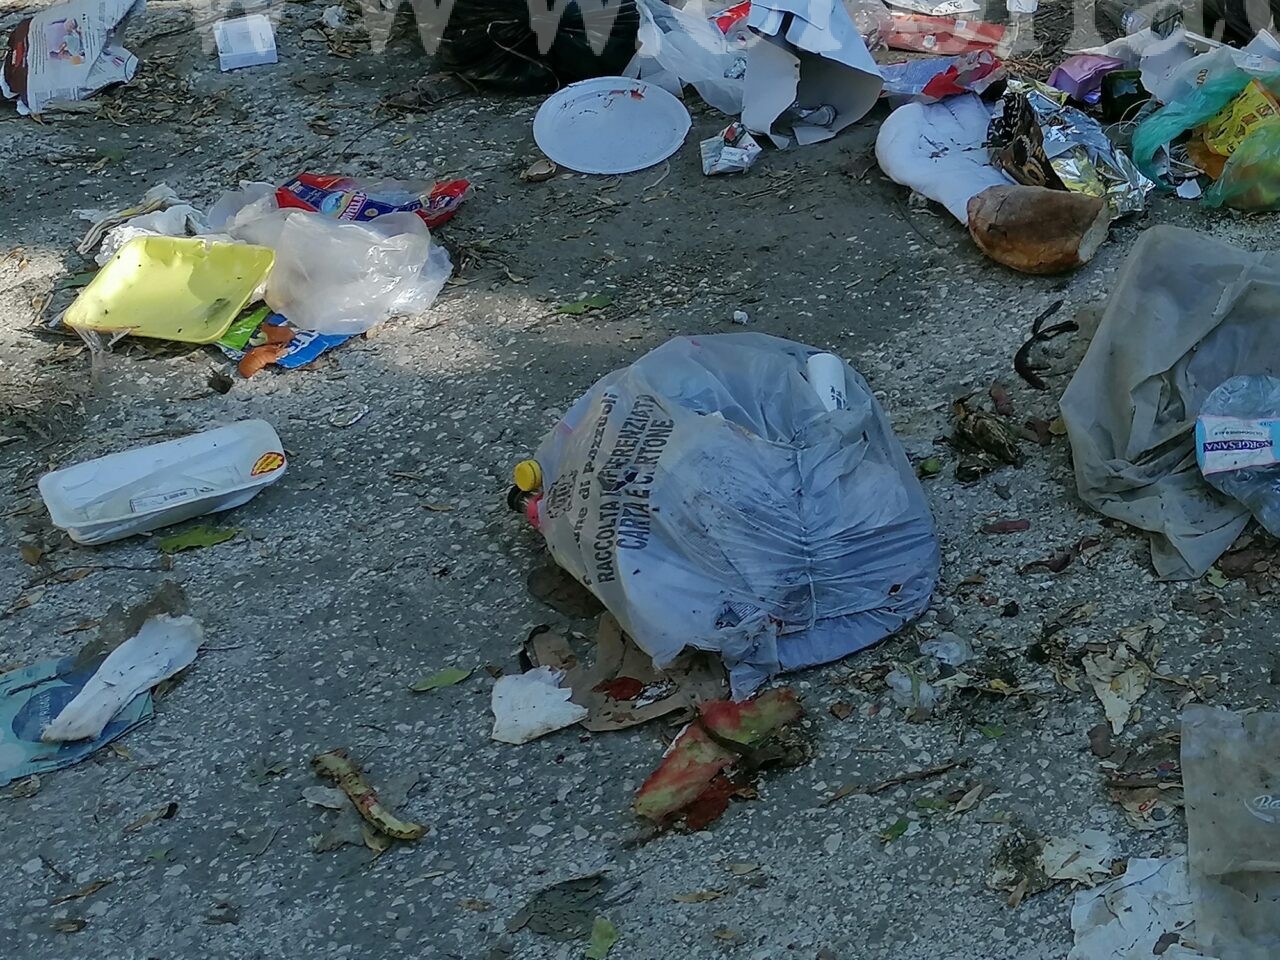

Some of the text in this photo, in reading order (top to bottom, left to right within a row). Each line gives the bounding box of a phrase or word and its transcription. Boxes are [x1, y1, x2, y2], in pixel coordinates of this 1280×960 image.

[583, 392, 619, 474] Pozzuoli
[577, 479, 592, 500] di
[615, 418, 675, 550] CARTA E CRTONE
[593, 500, 622, 583] RACCOLTA
